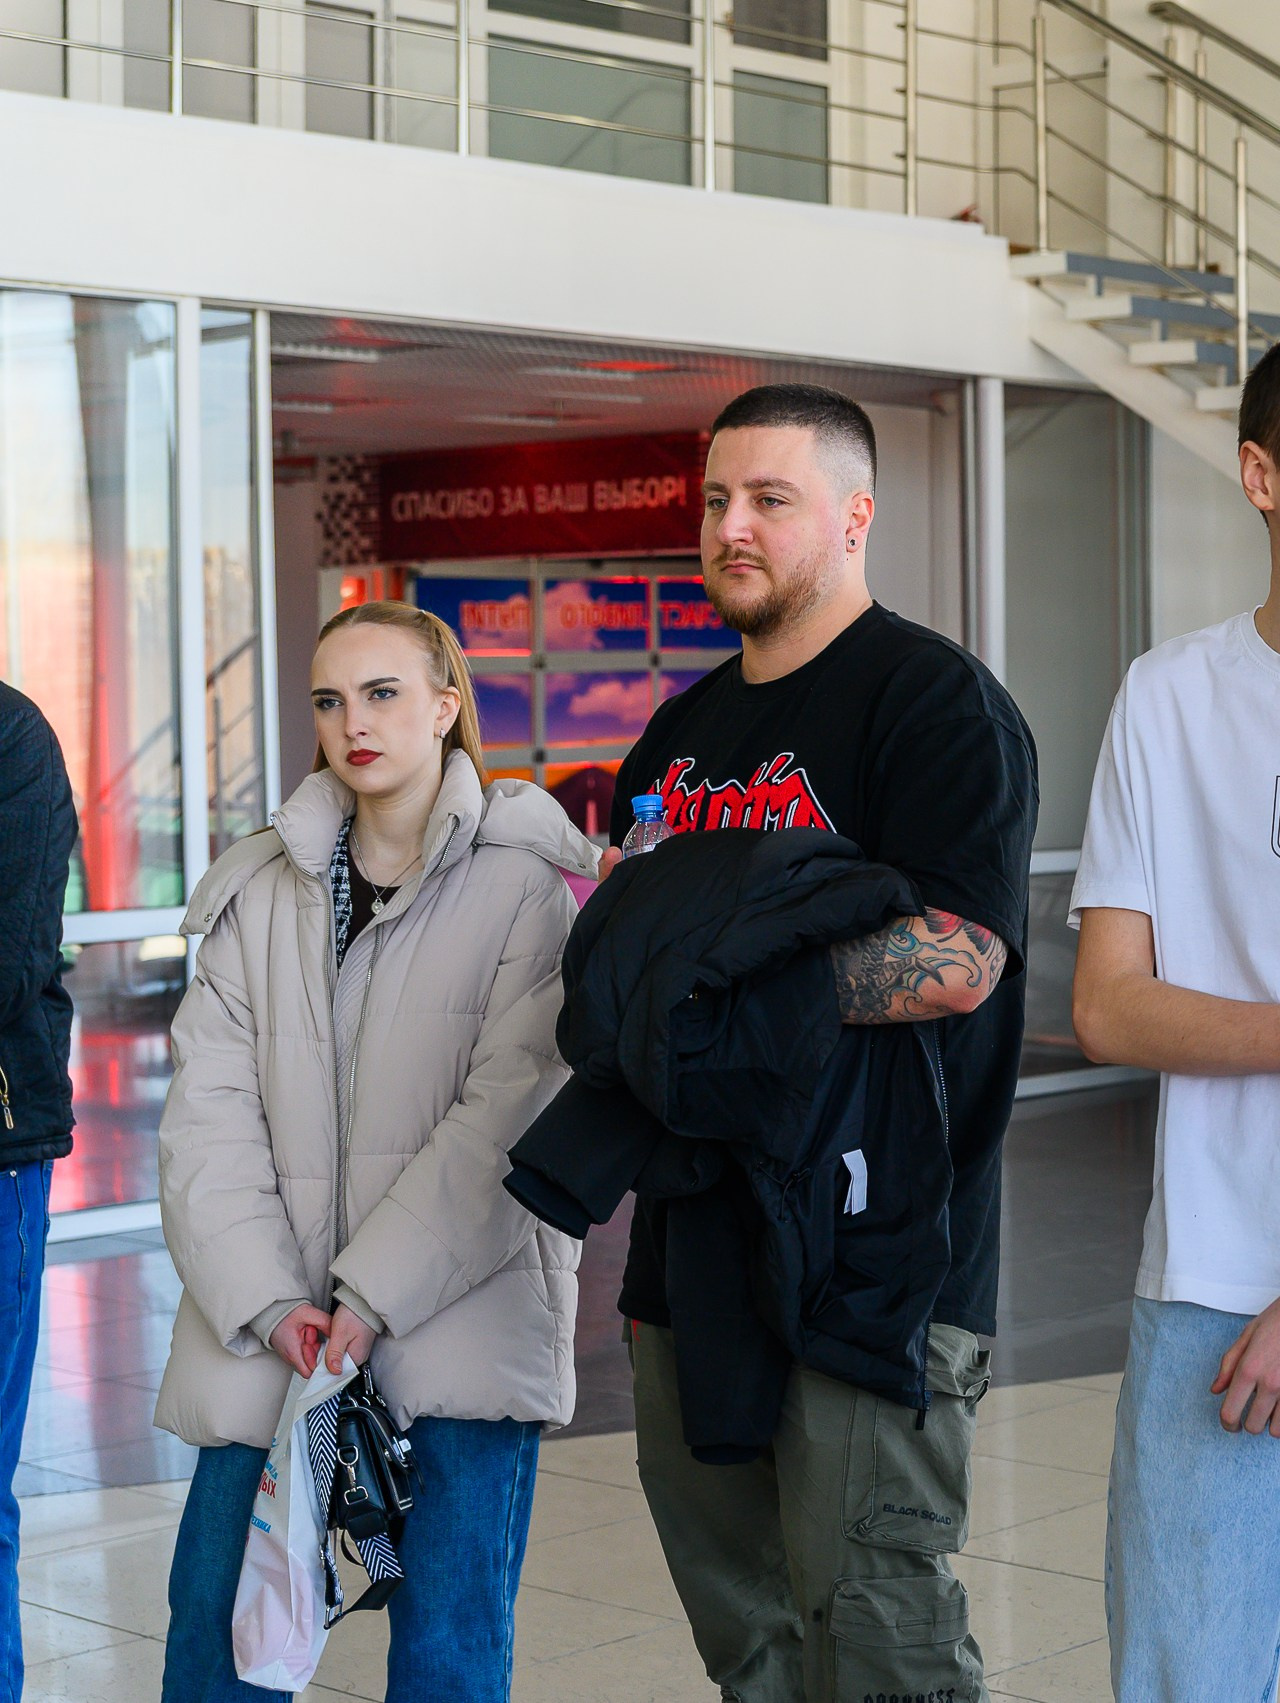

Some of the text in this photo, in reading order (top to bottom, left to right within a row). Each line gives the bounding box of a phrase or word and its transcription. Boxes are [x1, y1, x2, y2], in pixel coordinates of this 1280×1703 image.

[391, 475, 687, 522] СПАСИБО ЗА ВАШ ВЫБОР!
[882, 1503, 952, 1526] BLACK SQUAD
